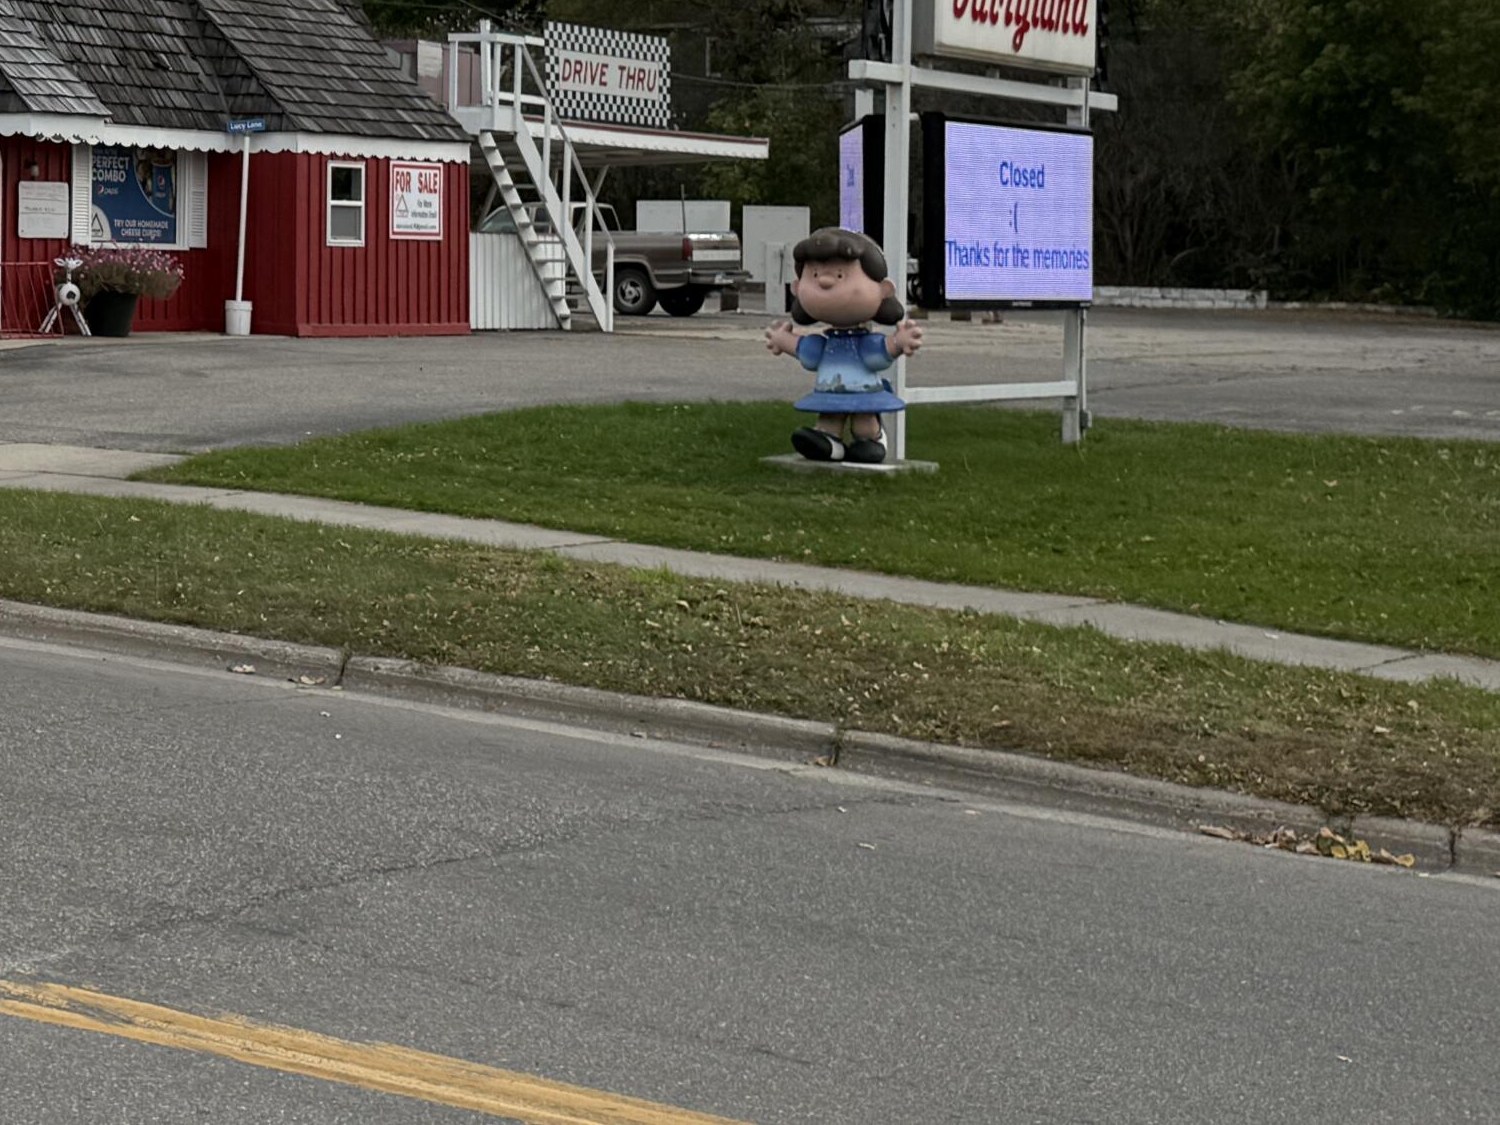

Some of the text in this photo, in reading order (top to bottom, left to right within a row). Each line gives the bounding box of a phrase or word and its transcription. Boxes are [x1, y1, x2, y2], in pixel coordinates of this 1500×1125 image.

[561, 58, 657, 92] DRIVE THRU
[91, 155, 130, 171] PERFECT
[91, 167, 127, 183] COMBO
[999, 160, 1046, 190] Closed
[395, 170, 438, 194] FOR SALE
[125, 219, 137, 228] OUR
[945, 239, 1090, 270] Thanks for the memories
